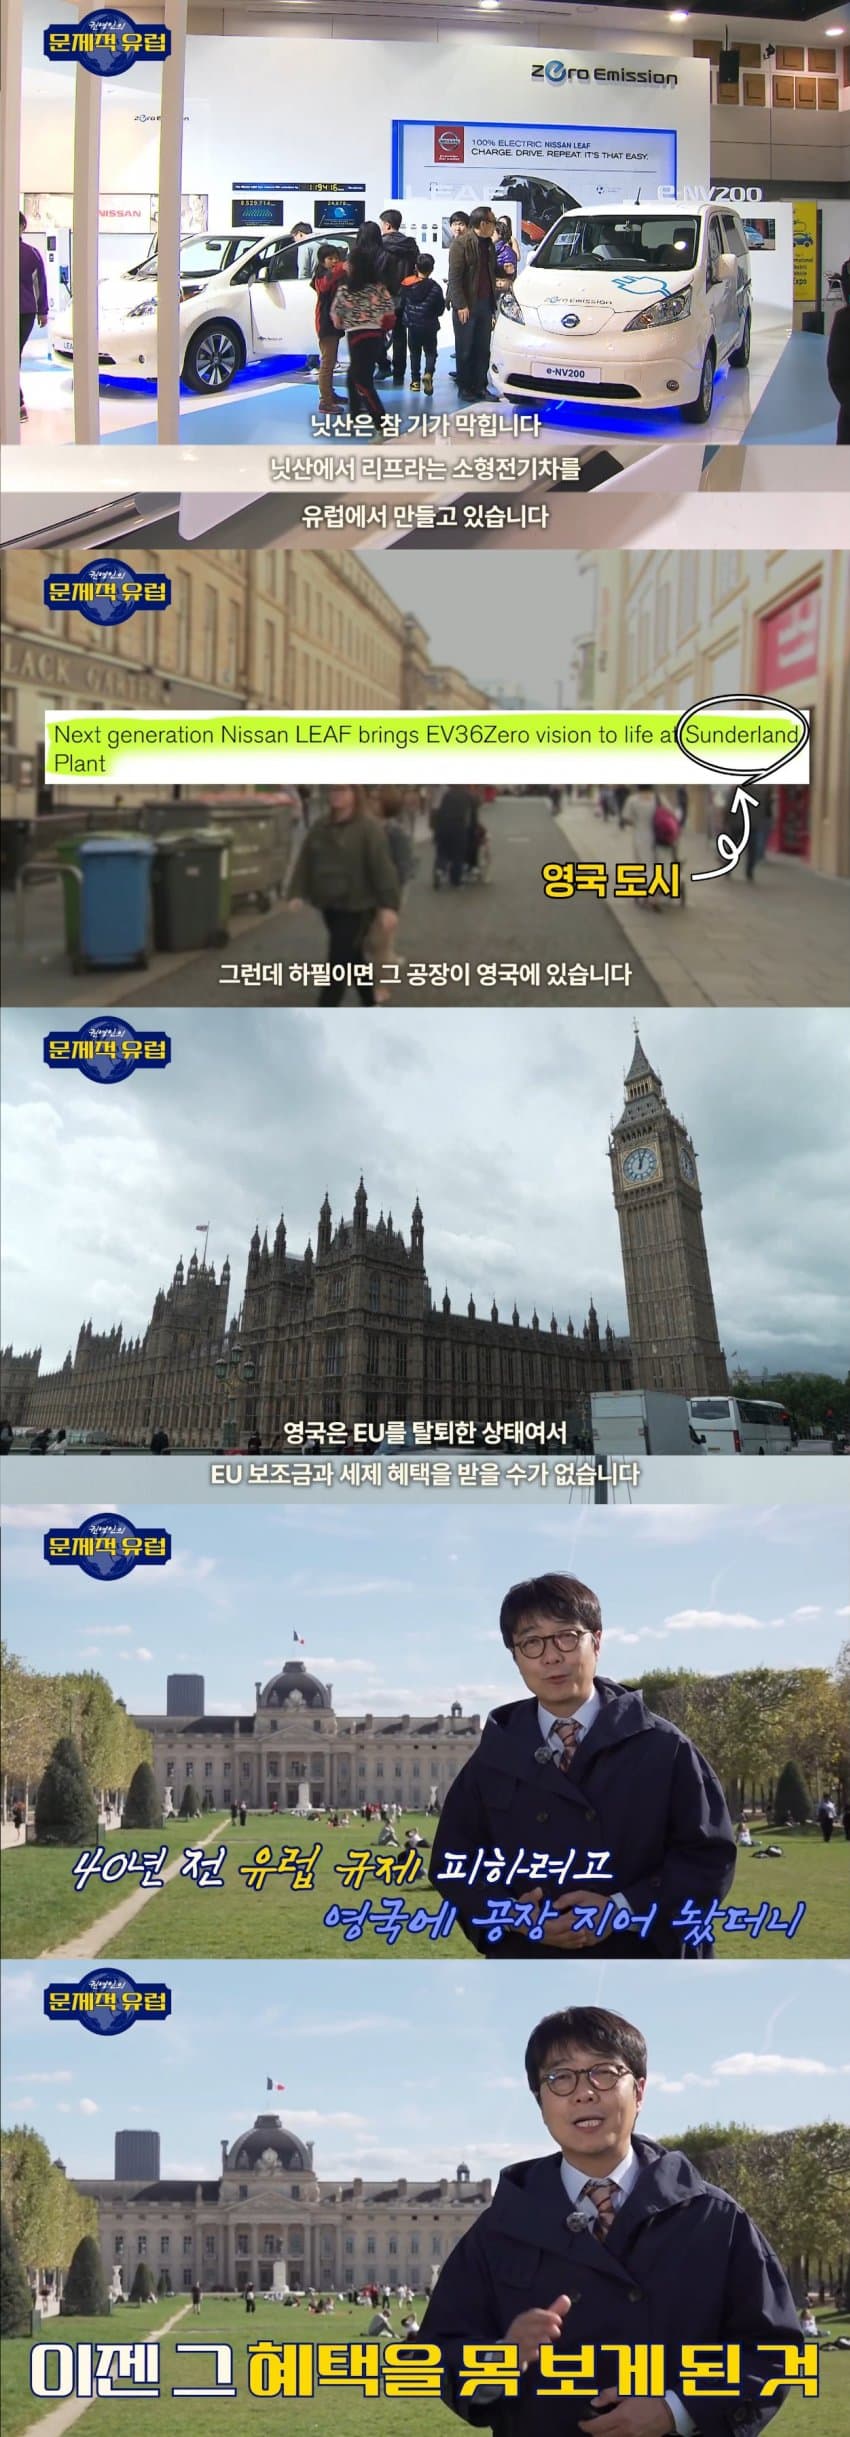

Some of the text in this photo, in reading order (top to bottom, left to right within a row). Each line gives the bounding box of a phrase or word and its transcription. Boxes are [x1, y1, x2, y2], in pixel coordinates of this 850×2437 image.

[594, 68, 678, 85] Emission
[472, 139, 496, 147] 100%
[498, 140, 542, 148] ELECTRIC
[544, 141, 571, 149] NISSAN
[602, 152, 623, 160] THAT
[657, 185, 763, 202] e-NV200
[546, 367, 585, 379] e-NV200
